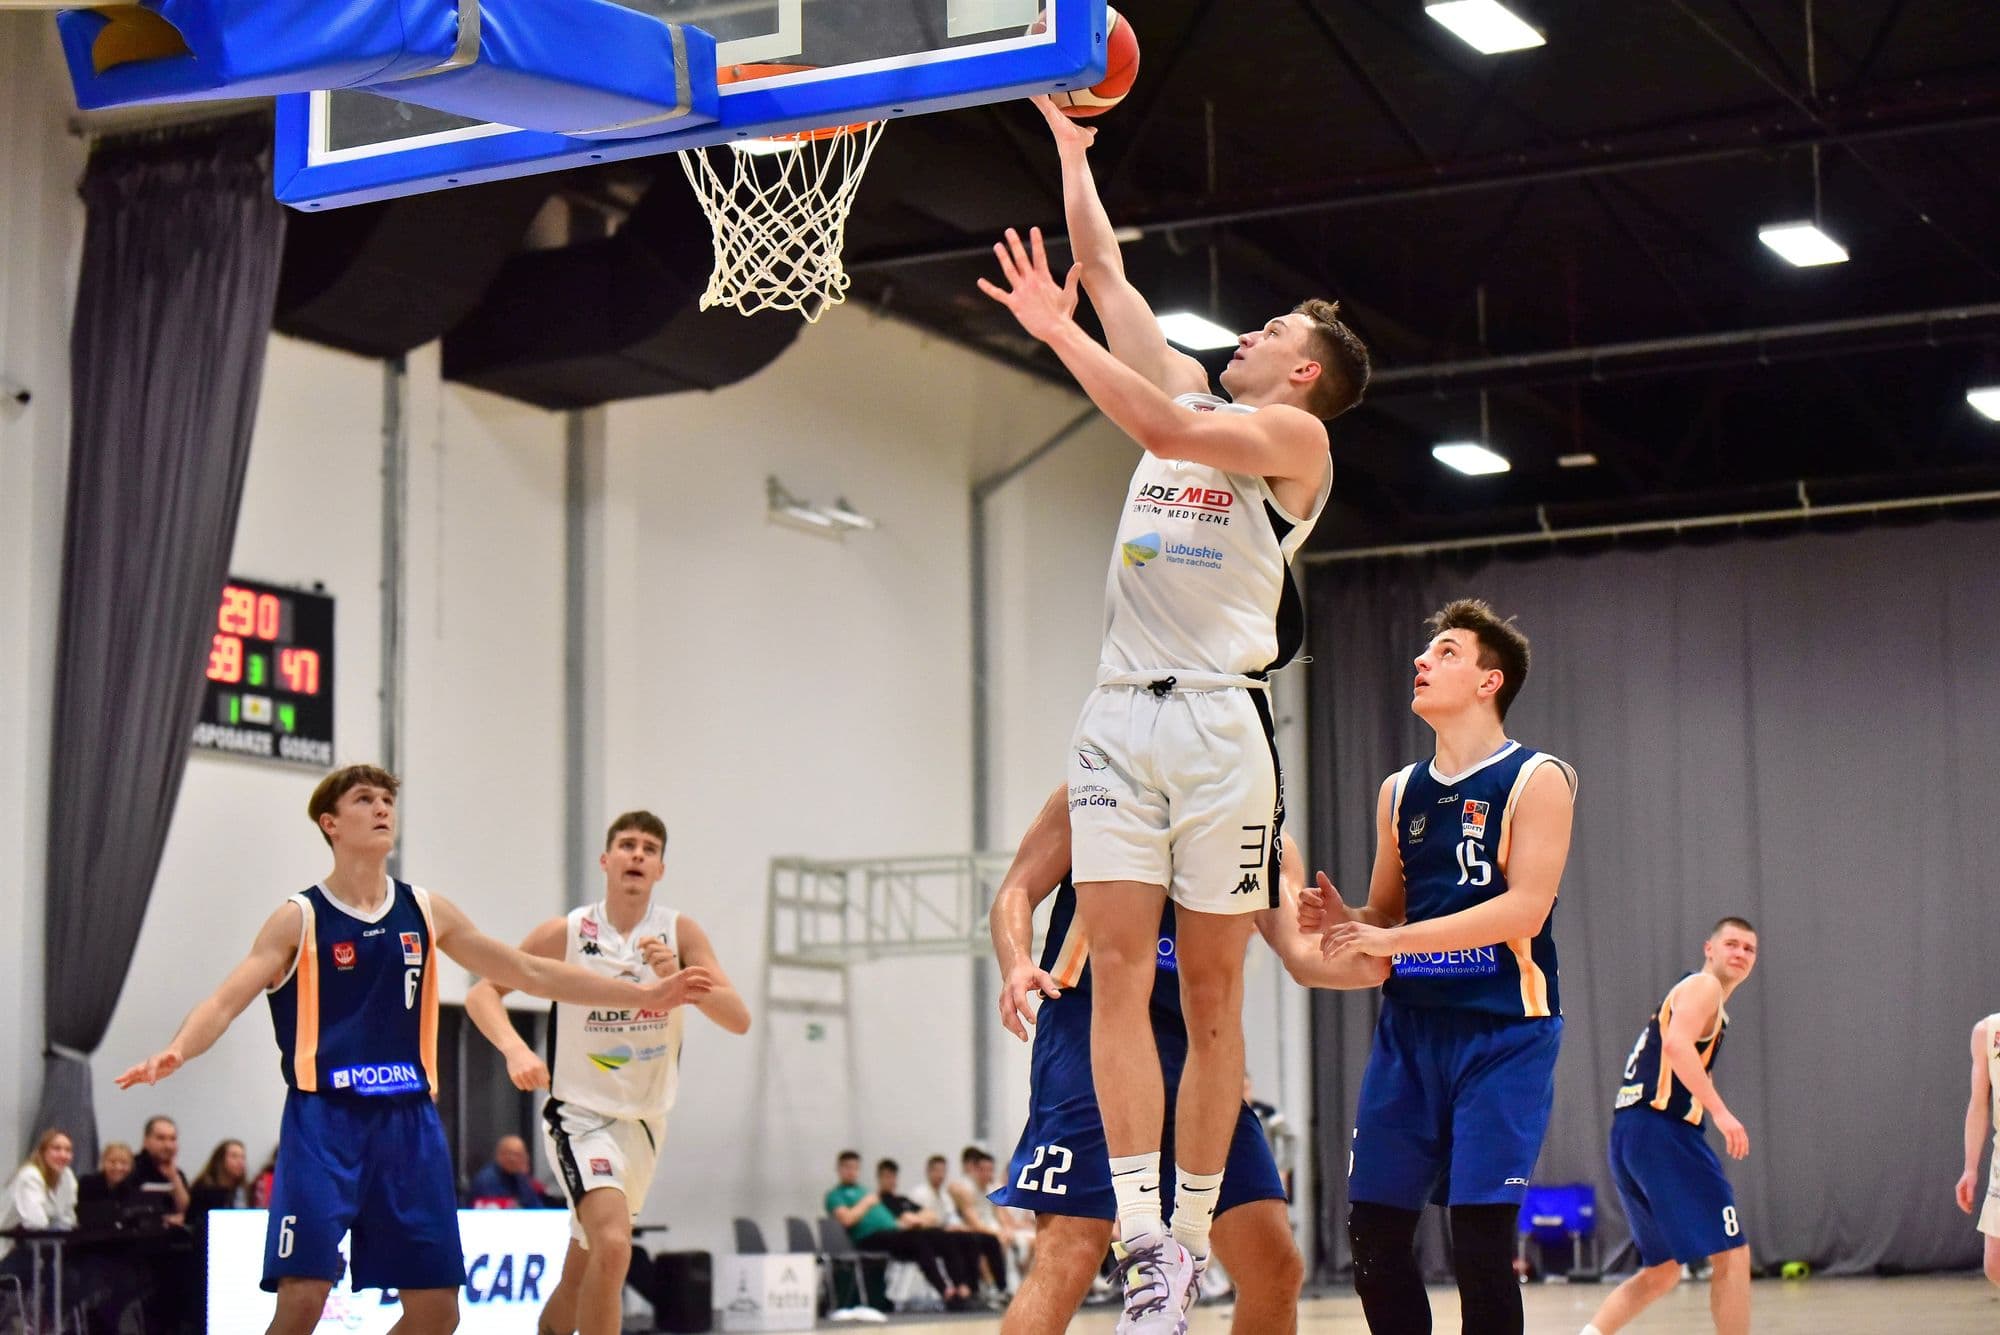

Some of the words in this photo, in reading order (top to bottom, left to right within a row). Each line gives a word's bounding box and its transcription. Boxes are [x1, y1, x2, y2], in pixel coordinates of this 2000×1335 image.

[1167, 509, 1230, 526] MEDYCZNE
[1165, 541, 1223, 561] Lubuskie
[279, 647, 320, 695] 47
[1089, 794, 1118, 808] Góra
[1455, 838, 1492, 886] 15
[404, 968, 422, 1010] 6
[351, 1065, 418, 1086] MODRN
[1016, 1144, 1074, 1196] 22
[278, 1215, 297, 1259] 6
[1722, 1205, 1740, 1237] 8
